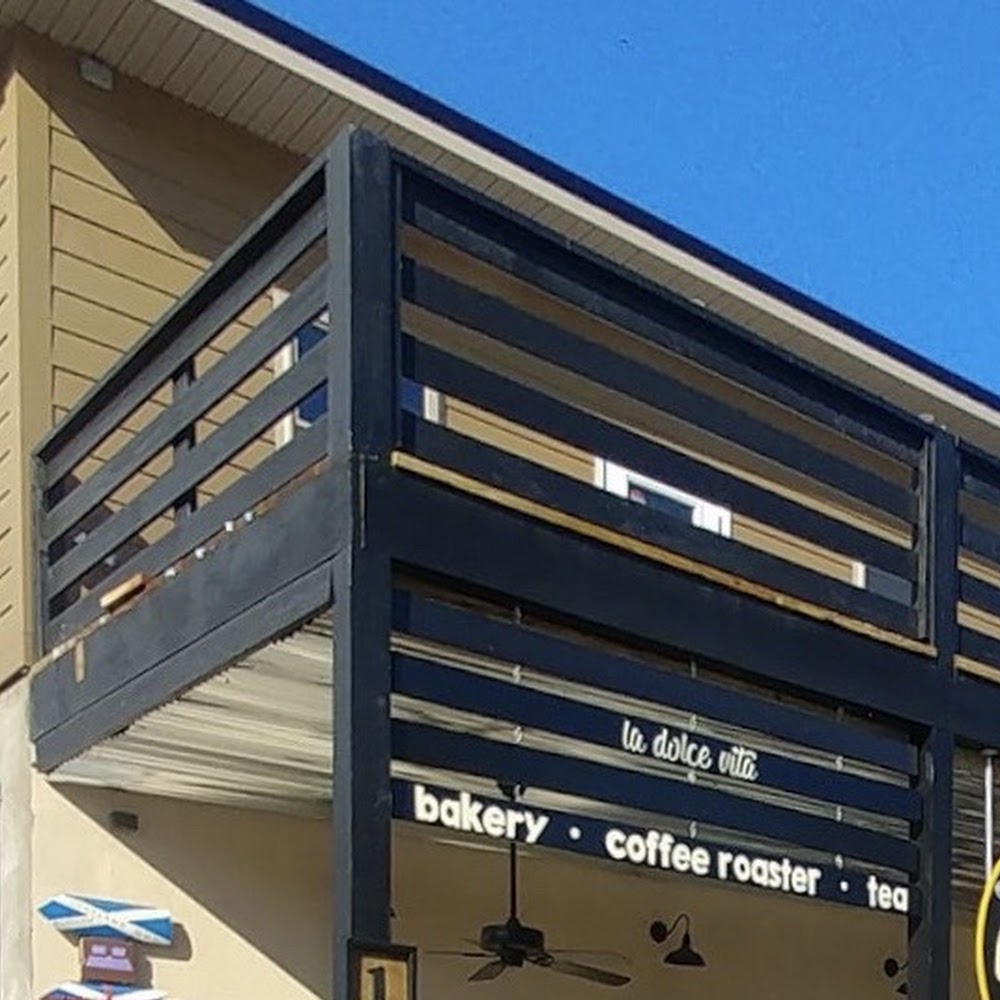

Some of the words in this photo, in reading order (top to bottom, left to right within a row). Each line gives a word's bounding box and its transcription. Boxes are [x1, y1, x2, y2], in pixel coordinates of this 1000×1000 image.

[622, 719, 647, 753] la
[652, 728, 713, 769] dolce
[718, 745, 759, 781] vita
[413, 784, 550, 844] bakery
[605, 827, 710, 876] coffee
[717, 850, 822, 896] roaster
[866, 874, 909, 913] tea
